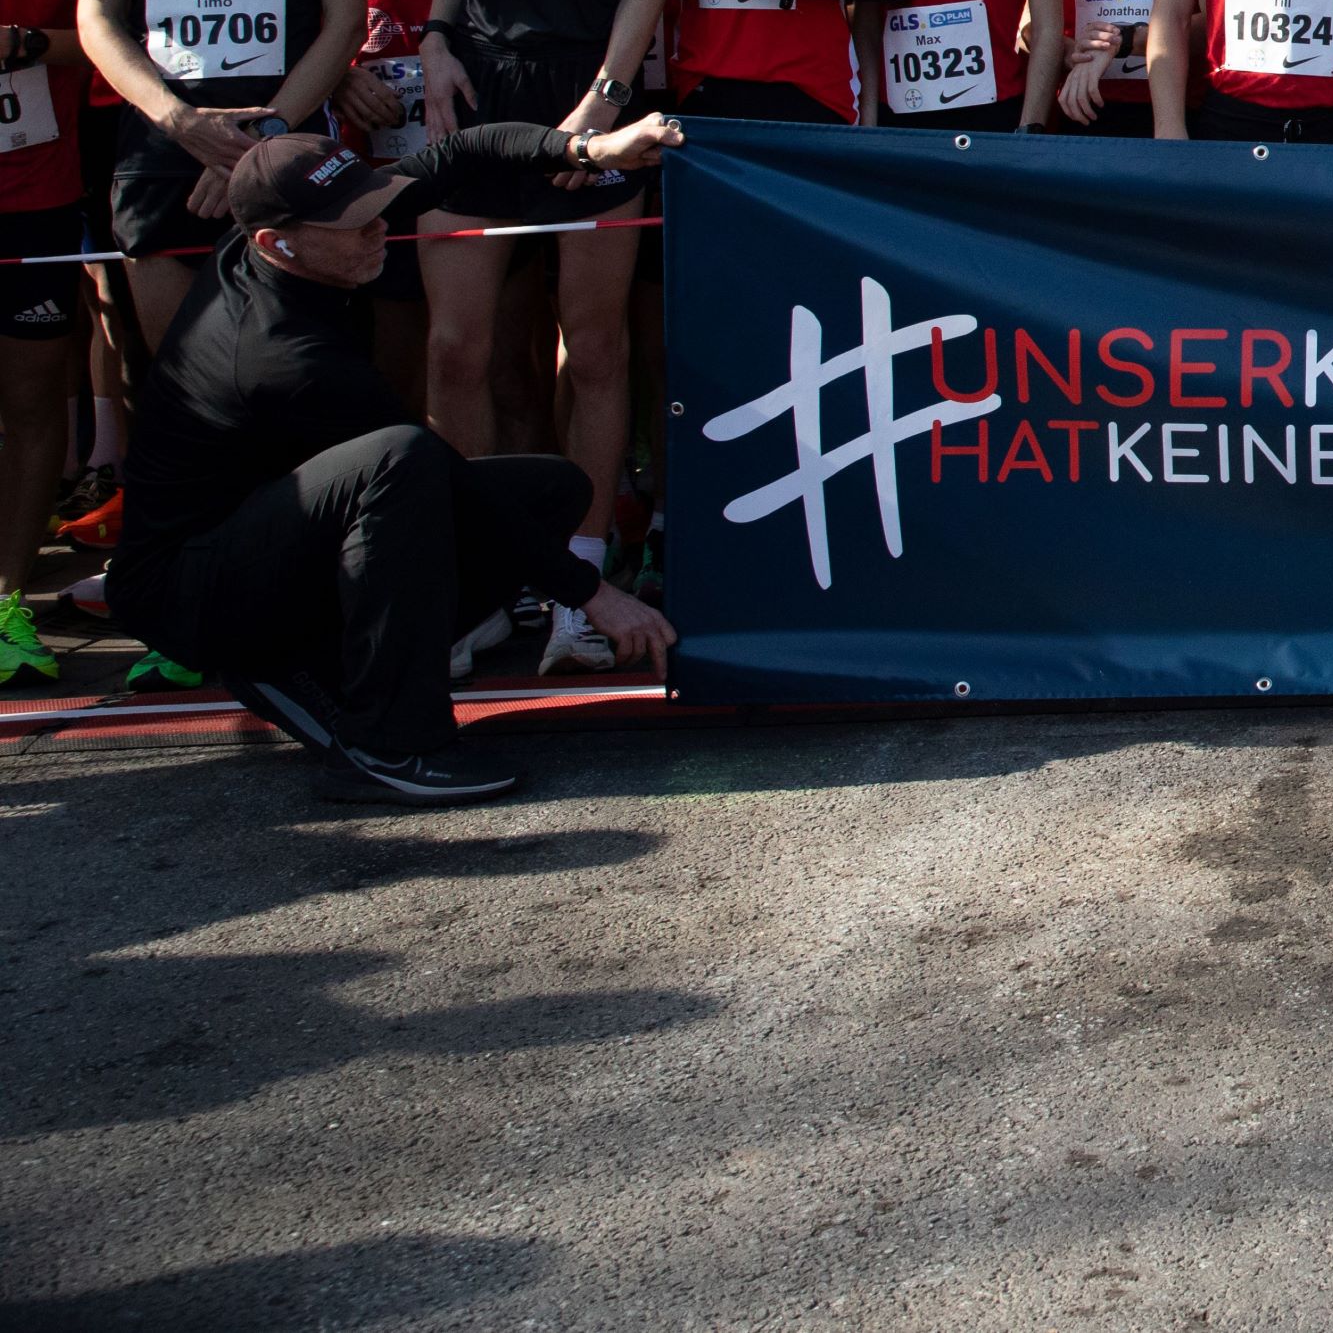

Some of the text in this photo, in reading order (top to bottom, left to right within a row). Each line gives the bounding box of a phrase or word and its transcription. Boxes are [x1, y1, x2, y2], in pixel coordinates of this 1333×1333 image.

[946, 10, 971, 20] PLAN
[1097, 6, 1149, 17] Jonathan
[157, 12, 278, 48] 10706
[1233, 11, 1333, 46] 10324
[916, 34, 941, 46] Max
[889, 45, 986, 83] 10323
[308, 156, 342, 184] TRACK
[13, 313, 68, 323] adidas
